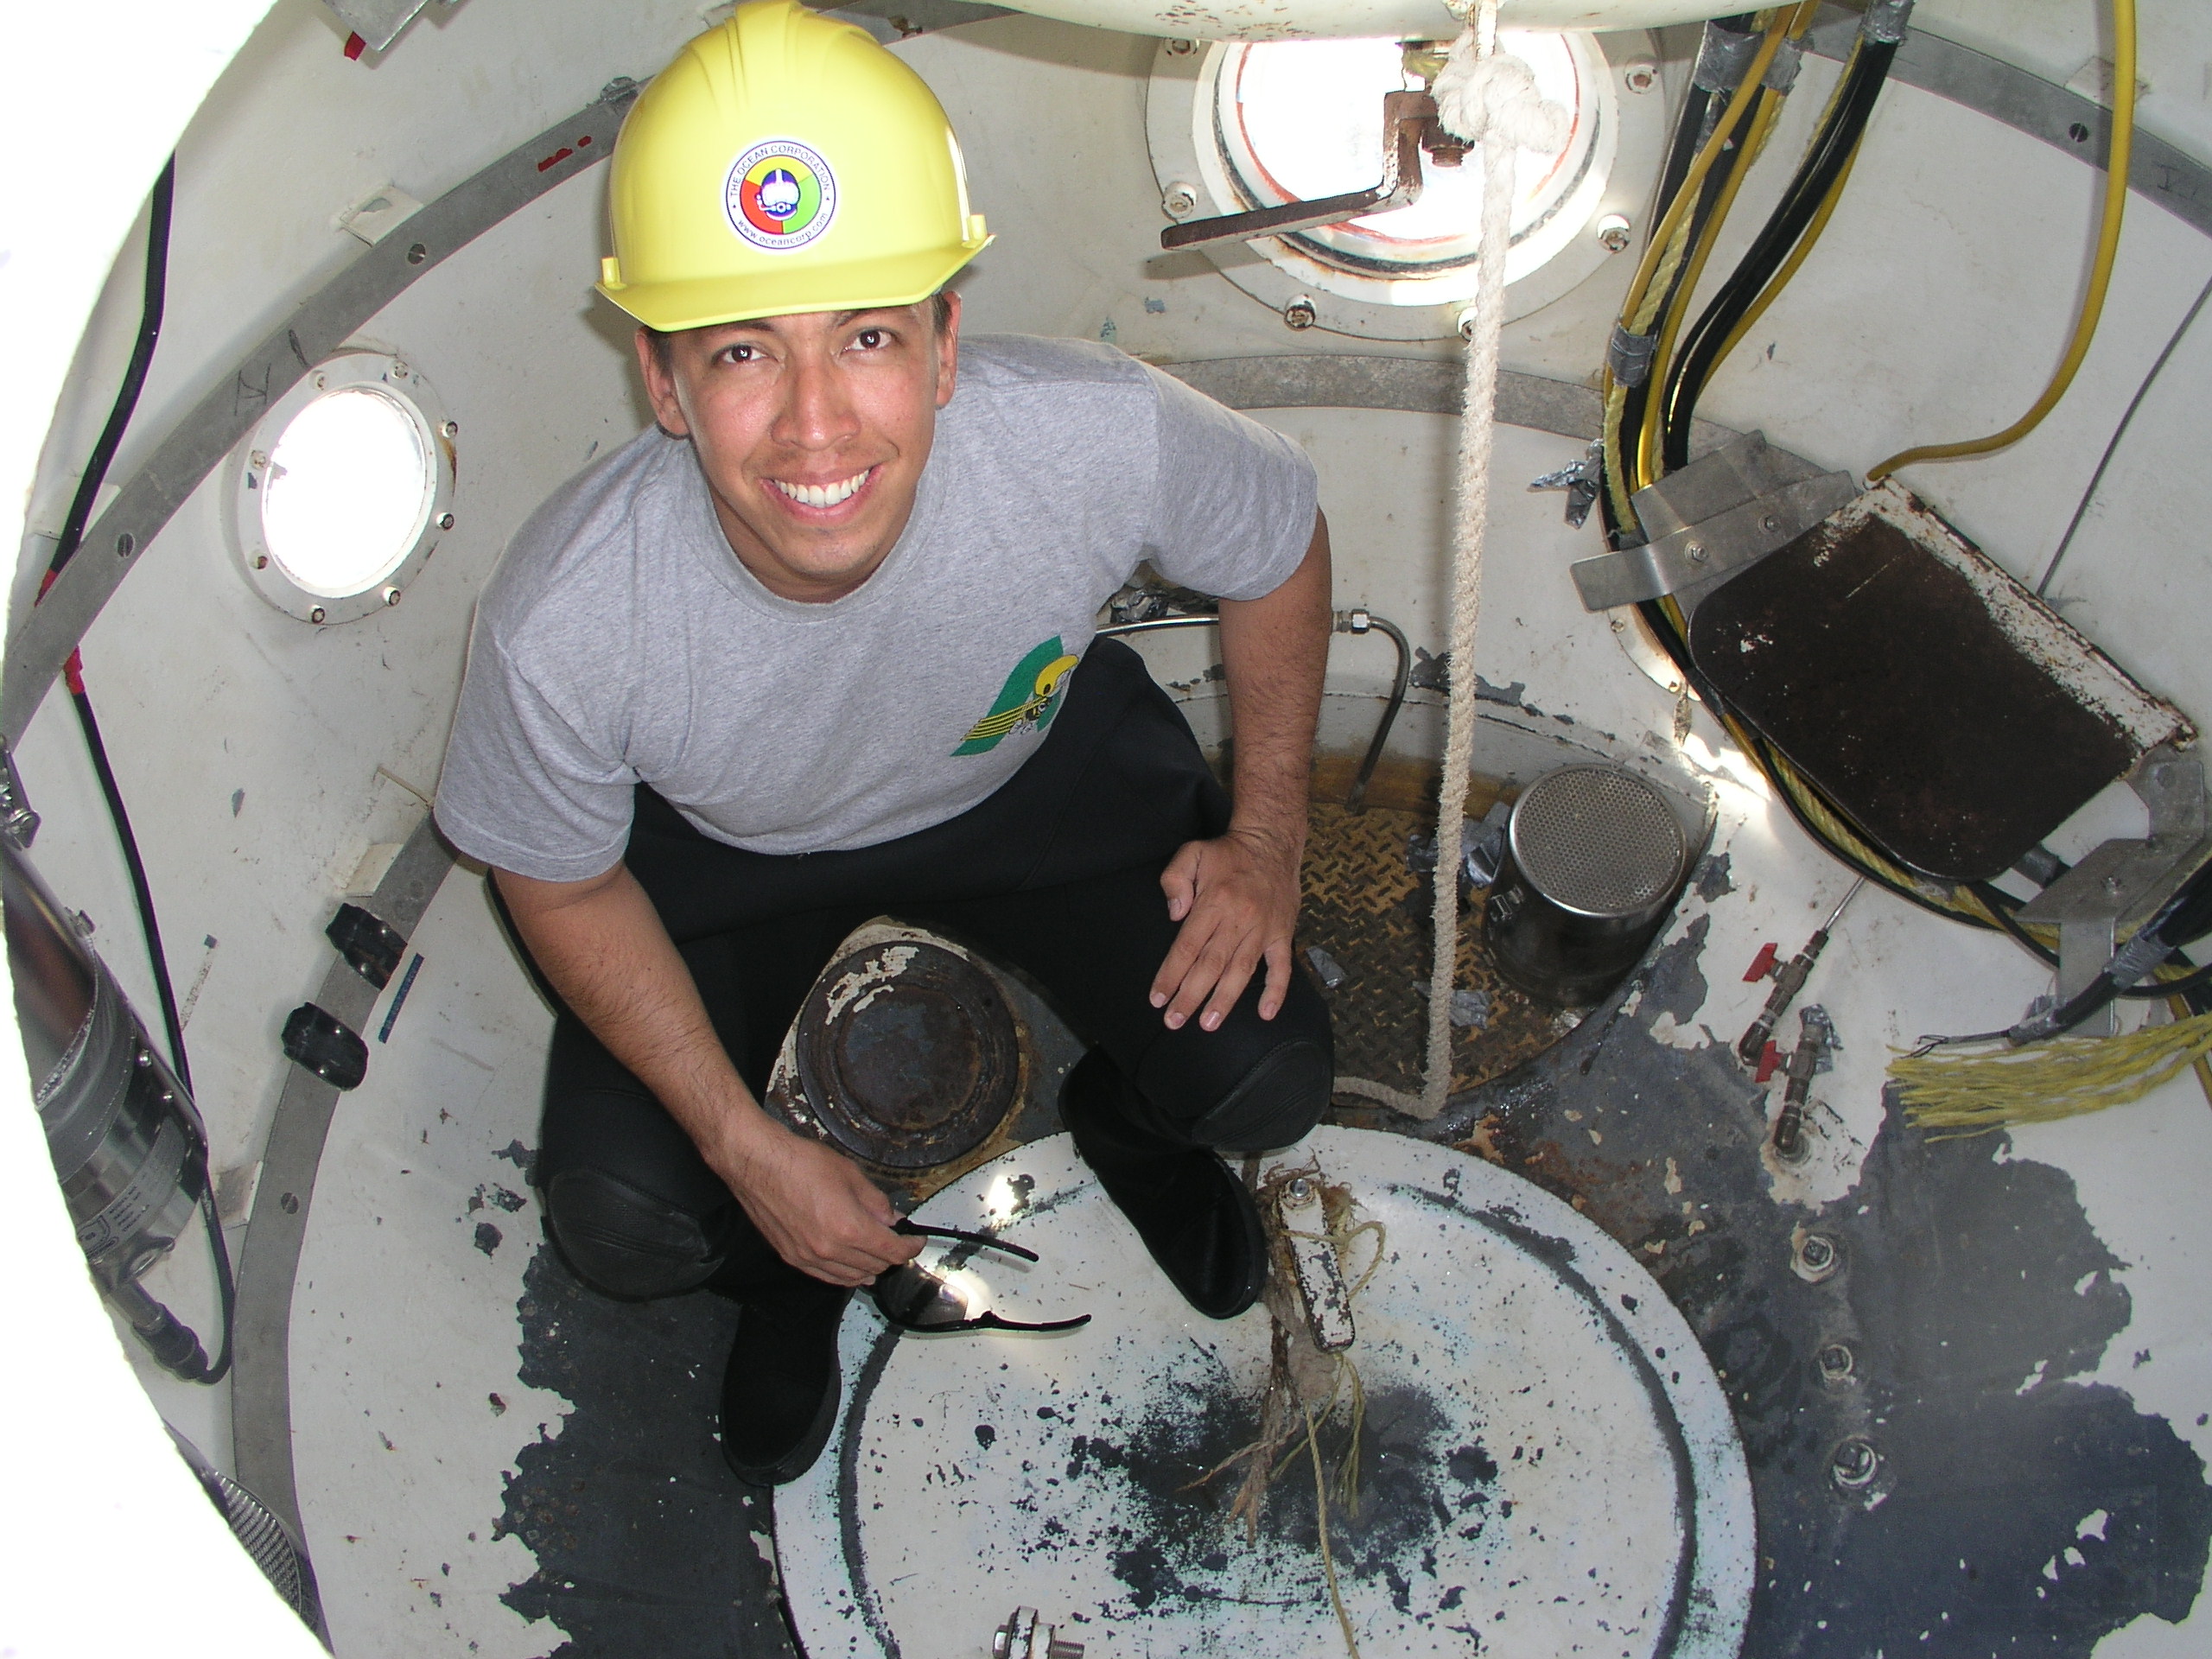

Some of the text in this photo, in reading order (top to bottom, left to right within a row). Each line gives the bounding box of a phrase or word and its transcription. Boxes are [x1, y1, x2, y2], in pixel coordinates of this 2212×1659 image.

[730, 145, 830, 197] THE OCEAN CORPORATION
[738, 213, 828, 245] www.oceancorp.com
